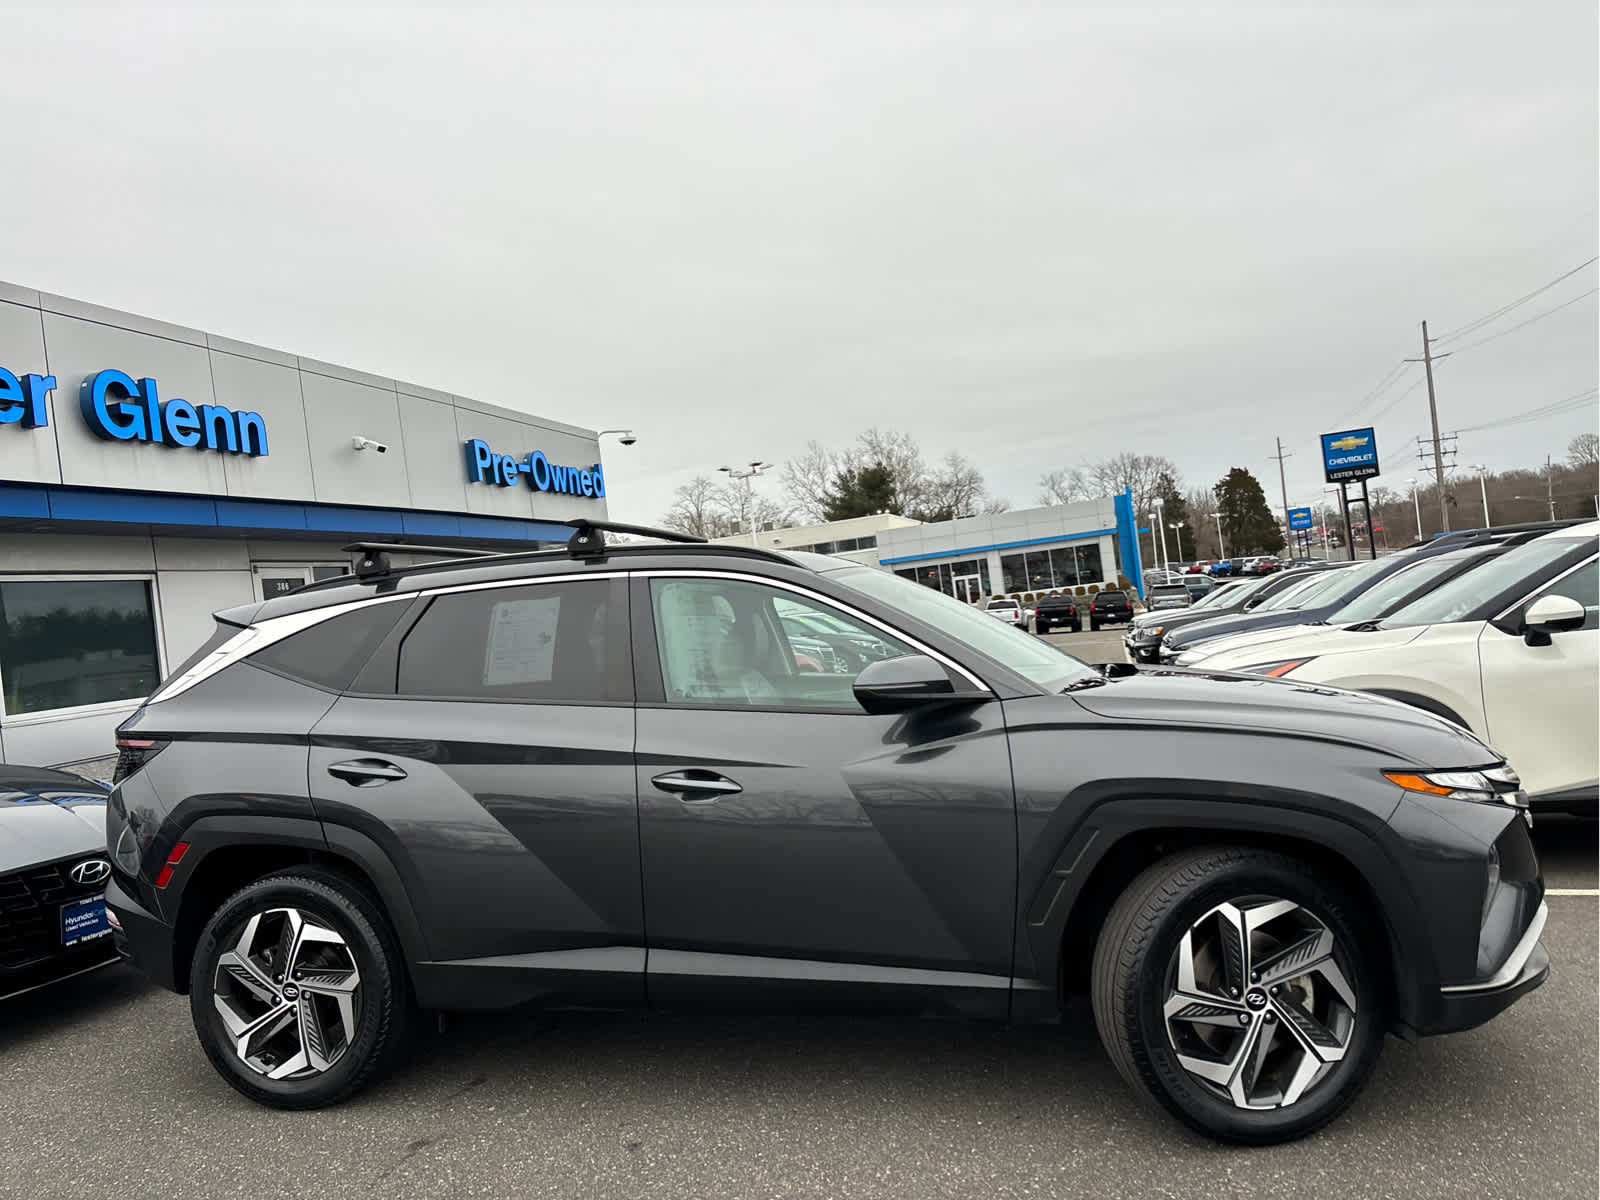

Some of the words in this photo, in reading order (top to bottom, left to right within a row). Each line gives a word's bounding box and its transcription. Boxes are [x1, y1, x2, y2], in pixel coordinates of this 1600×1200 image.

[80, 369, 269, 457] Glenn
[1328, 453, 1373, 465] CHEVROLET
[465, 439, 606, 498] Pre-Owned
[1330, 471, 1354, 480] LESTER
[1354, 468, 1376, 476] GLENN
[65, 911, 94, 925] Hyundai
